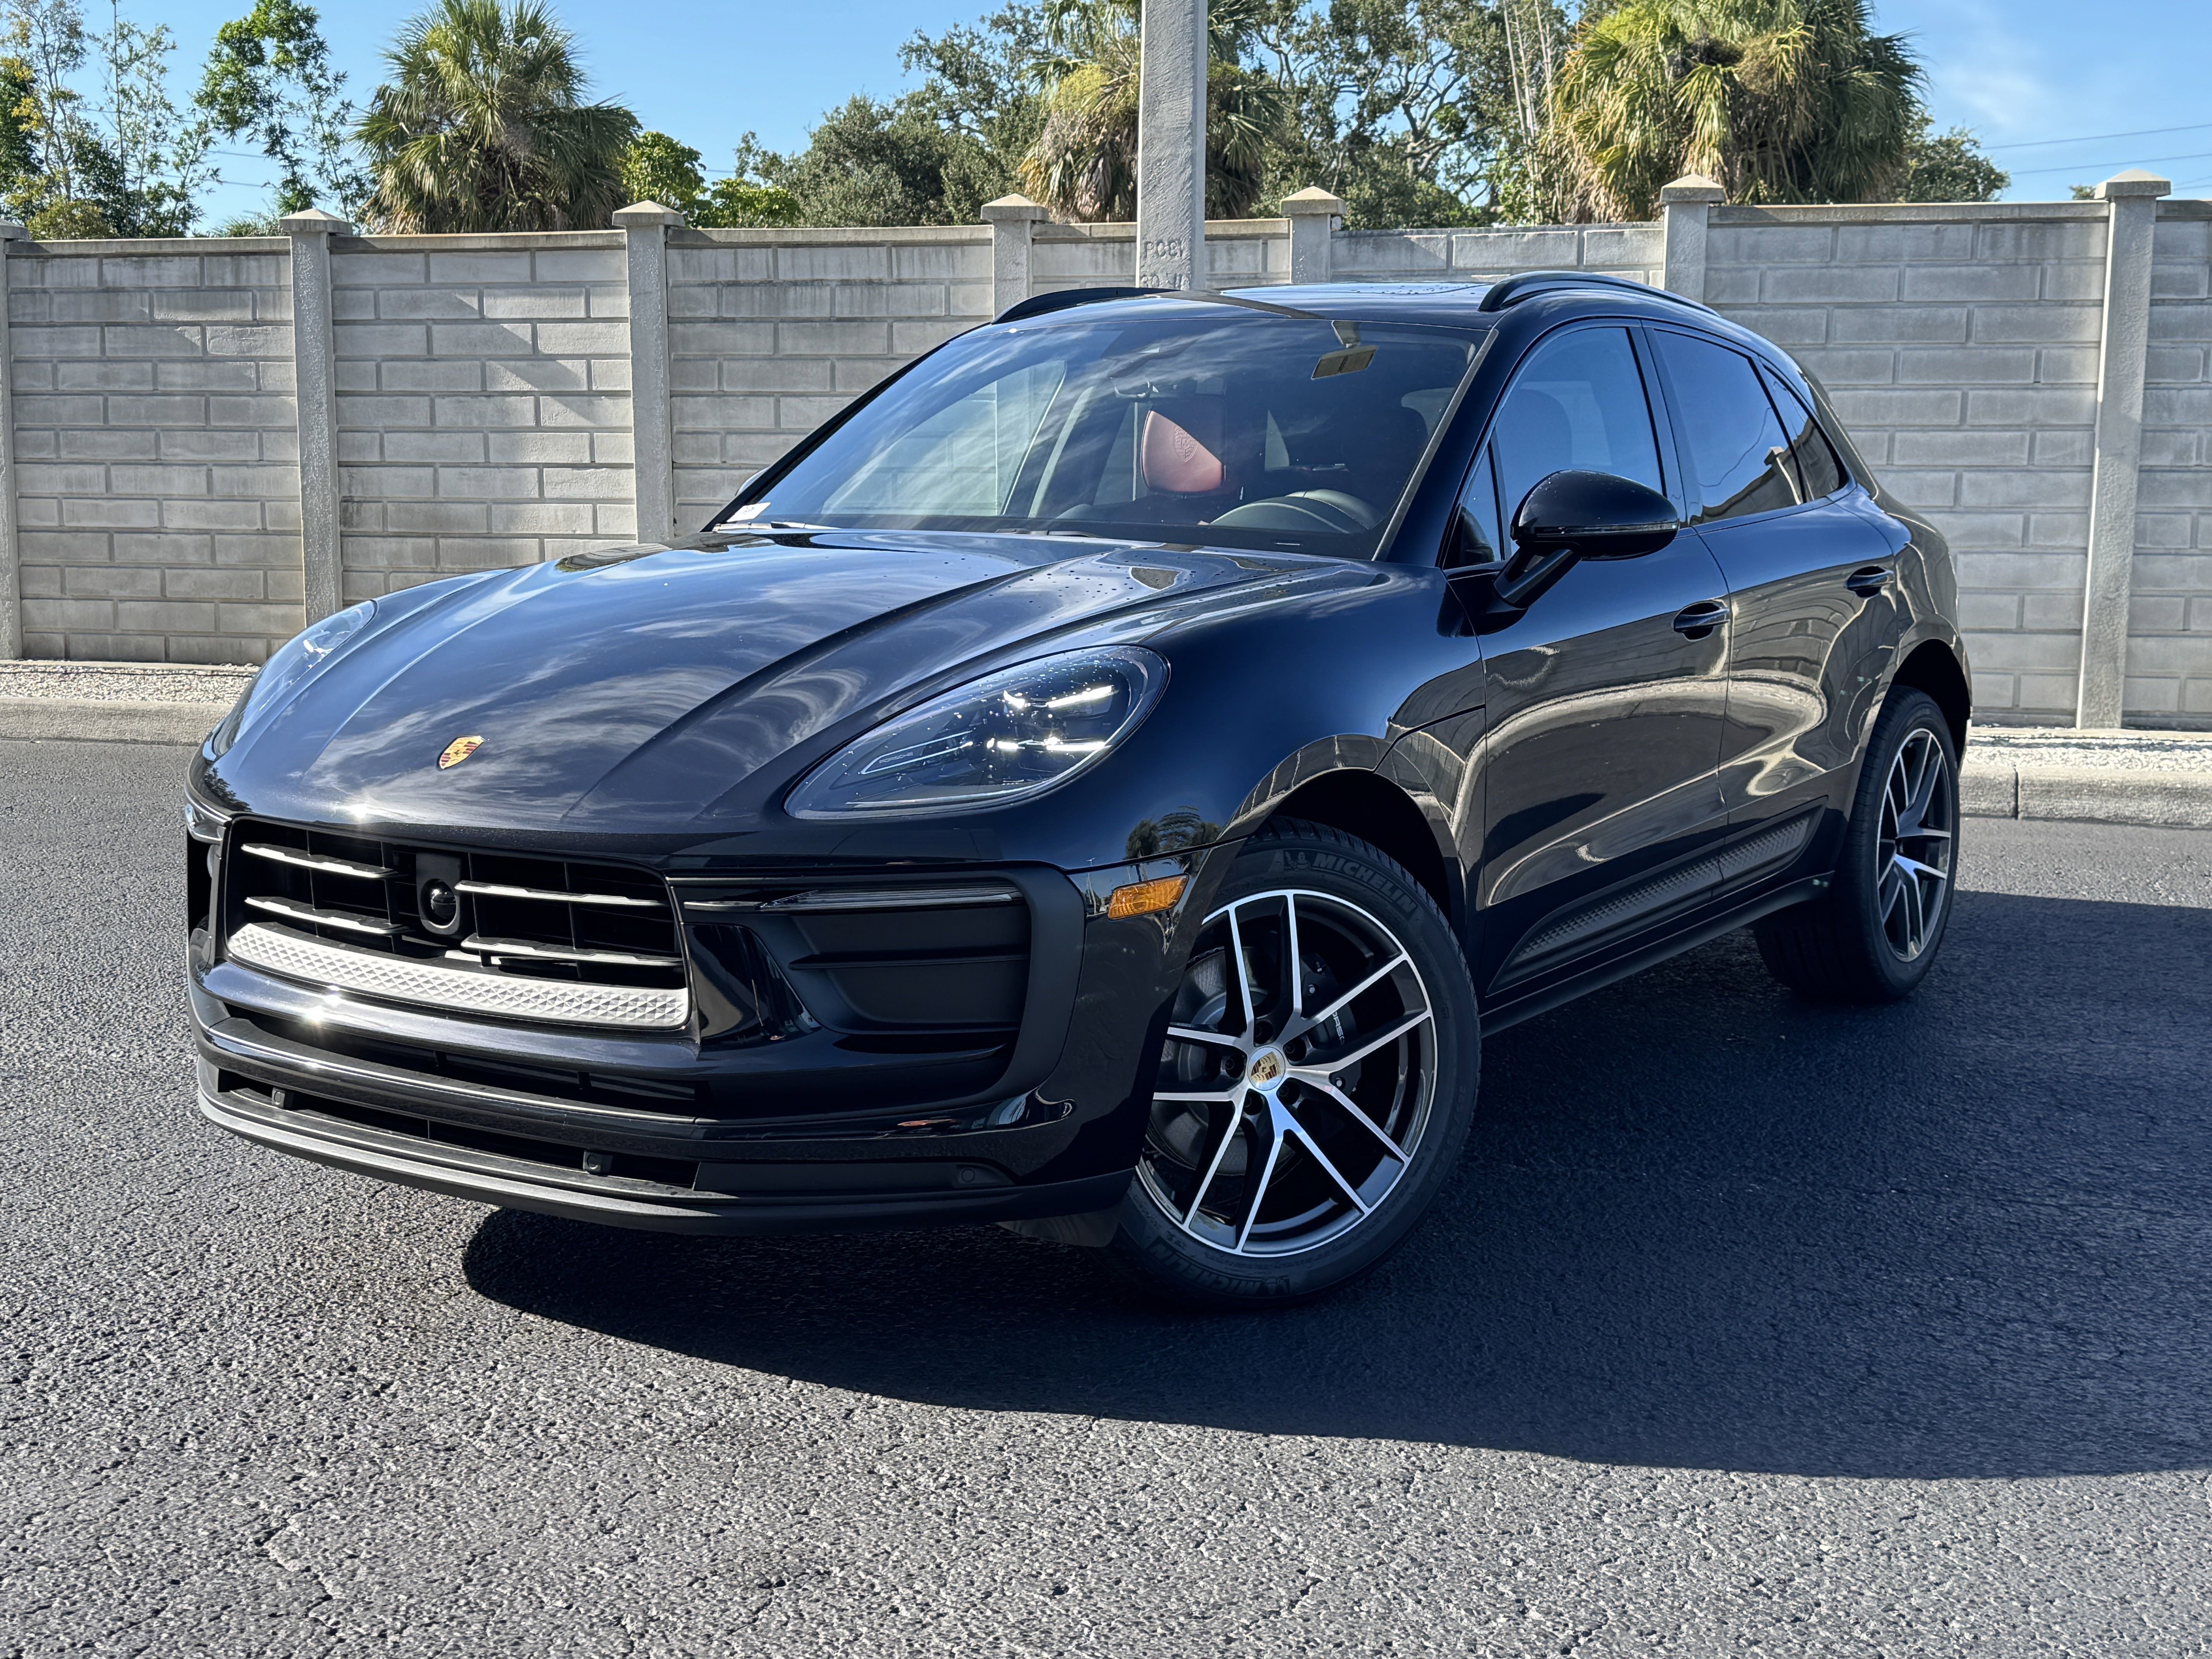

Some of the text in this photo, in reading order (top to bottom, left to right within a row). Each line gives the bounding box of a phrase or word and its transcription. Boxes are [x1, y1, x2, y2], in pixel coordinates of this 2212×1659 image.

[879, 752, 913, 763] PORSCHE
[1312, 852, 1417, 913] MICHELIN
[1332, 1011, 1345, 1045] ORSC
[1147, 1242, 1259, 1296] MICHELIN
